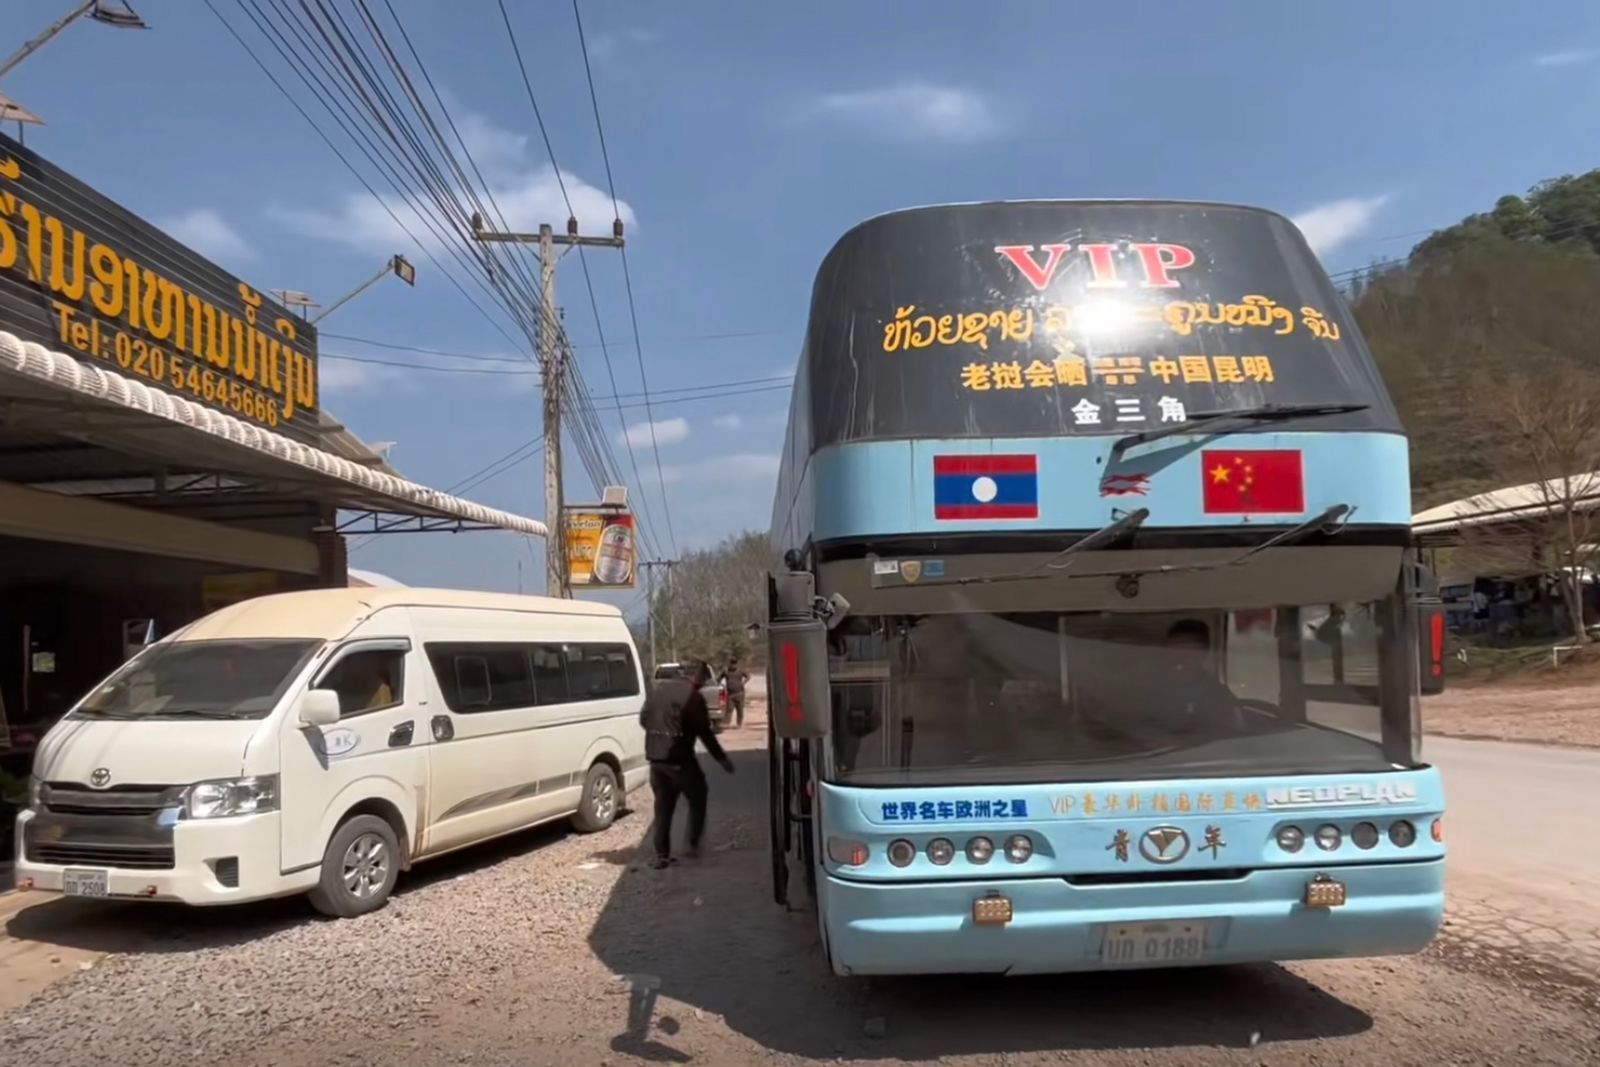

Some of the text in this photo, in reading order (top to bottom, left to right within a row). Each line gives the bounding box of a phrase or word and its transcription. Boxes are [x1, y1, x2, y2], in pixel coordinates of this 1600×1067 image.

[994, 243, 1196, 290] VIP
[53, 301, 279, 428] Tel: 020 54645666
[1149, 355, 1275, 384] 中国昆明
[881, 799, 1029, 820] 世界名车欧洲之星
[1266, 782, 1417, 810] NEOPLAN
